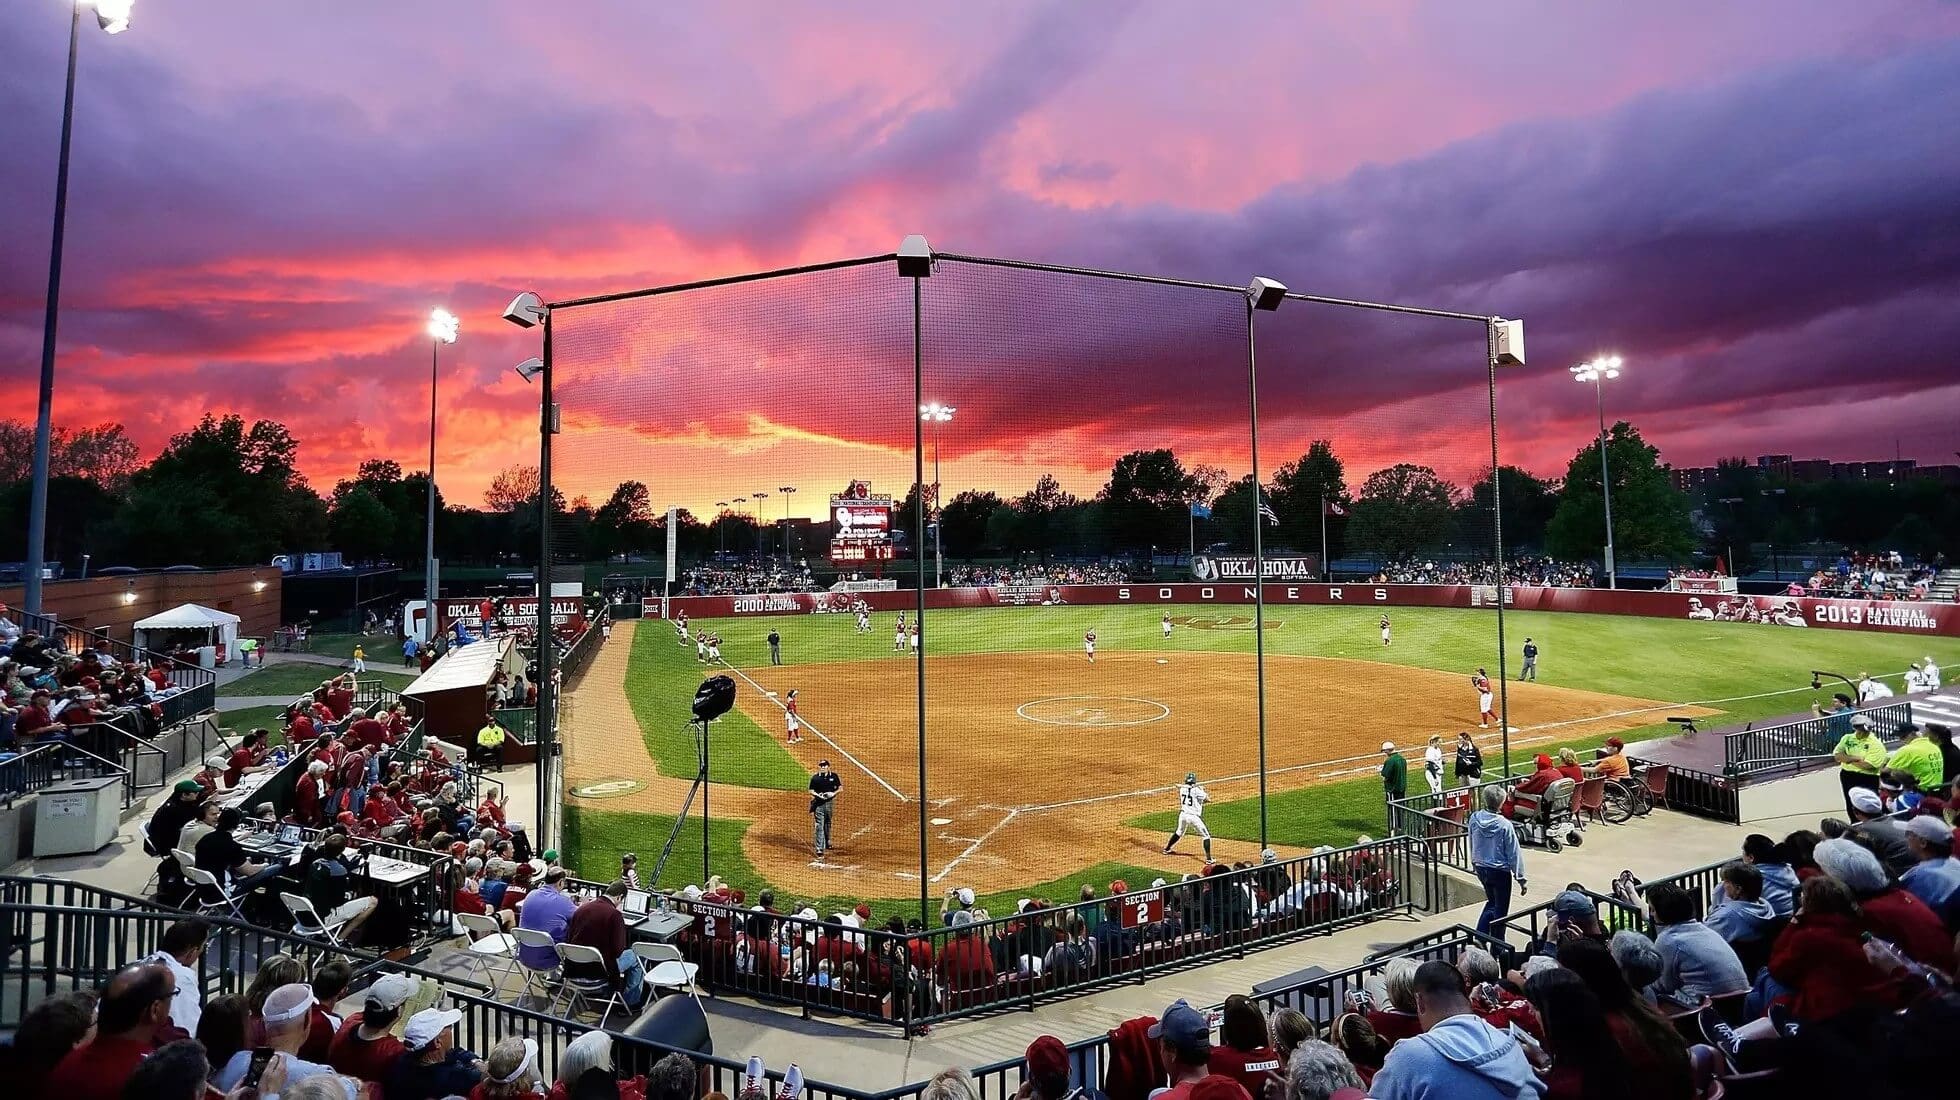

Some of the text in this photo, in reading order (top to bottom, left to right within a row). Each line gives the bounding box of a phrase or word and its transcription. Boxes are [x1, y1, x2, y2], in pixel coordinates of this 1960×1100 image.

[1221, 560, 1308, 576] OKLAHOMA
[519, 602, 578, 616] SOFBALL
[734, 599, 764, 612] 2000
[1815, 605, 1926, 623] 2013 NATIONAL
[1867, 616, 1937, 628] CHAMPIONS
[1125, 891, 1160, 906] SECTION
[692, 904, 727, 918] SECTION
[1137, 903, 1148, 924] 2
[704, 915, 716, 937] 2
